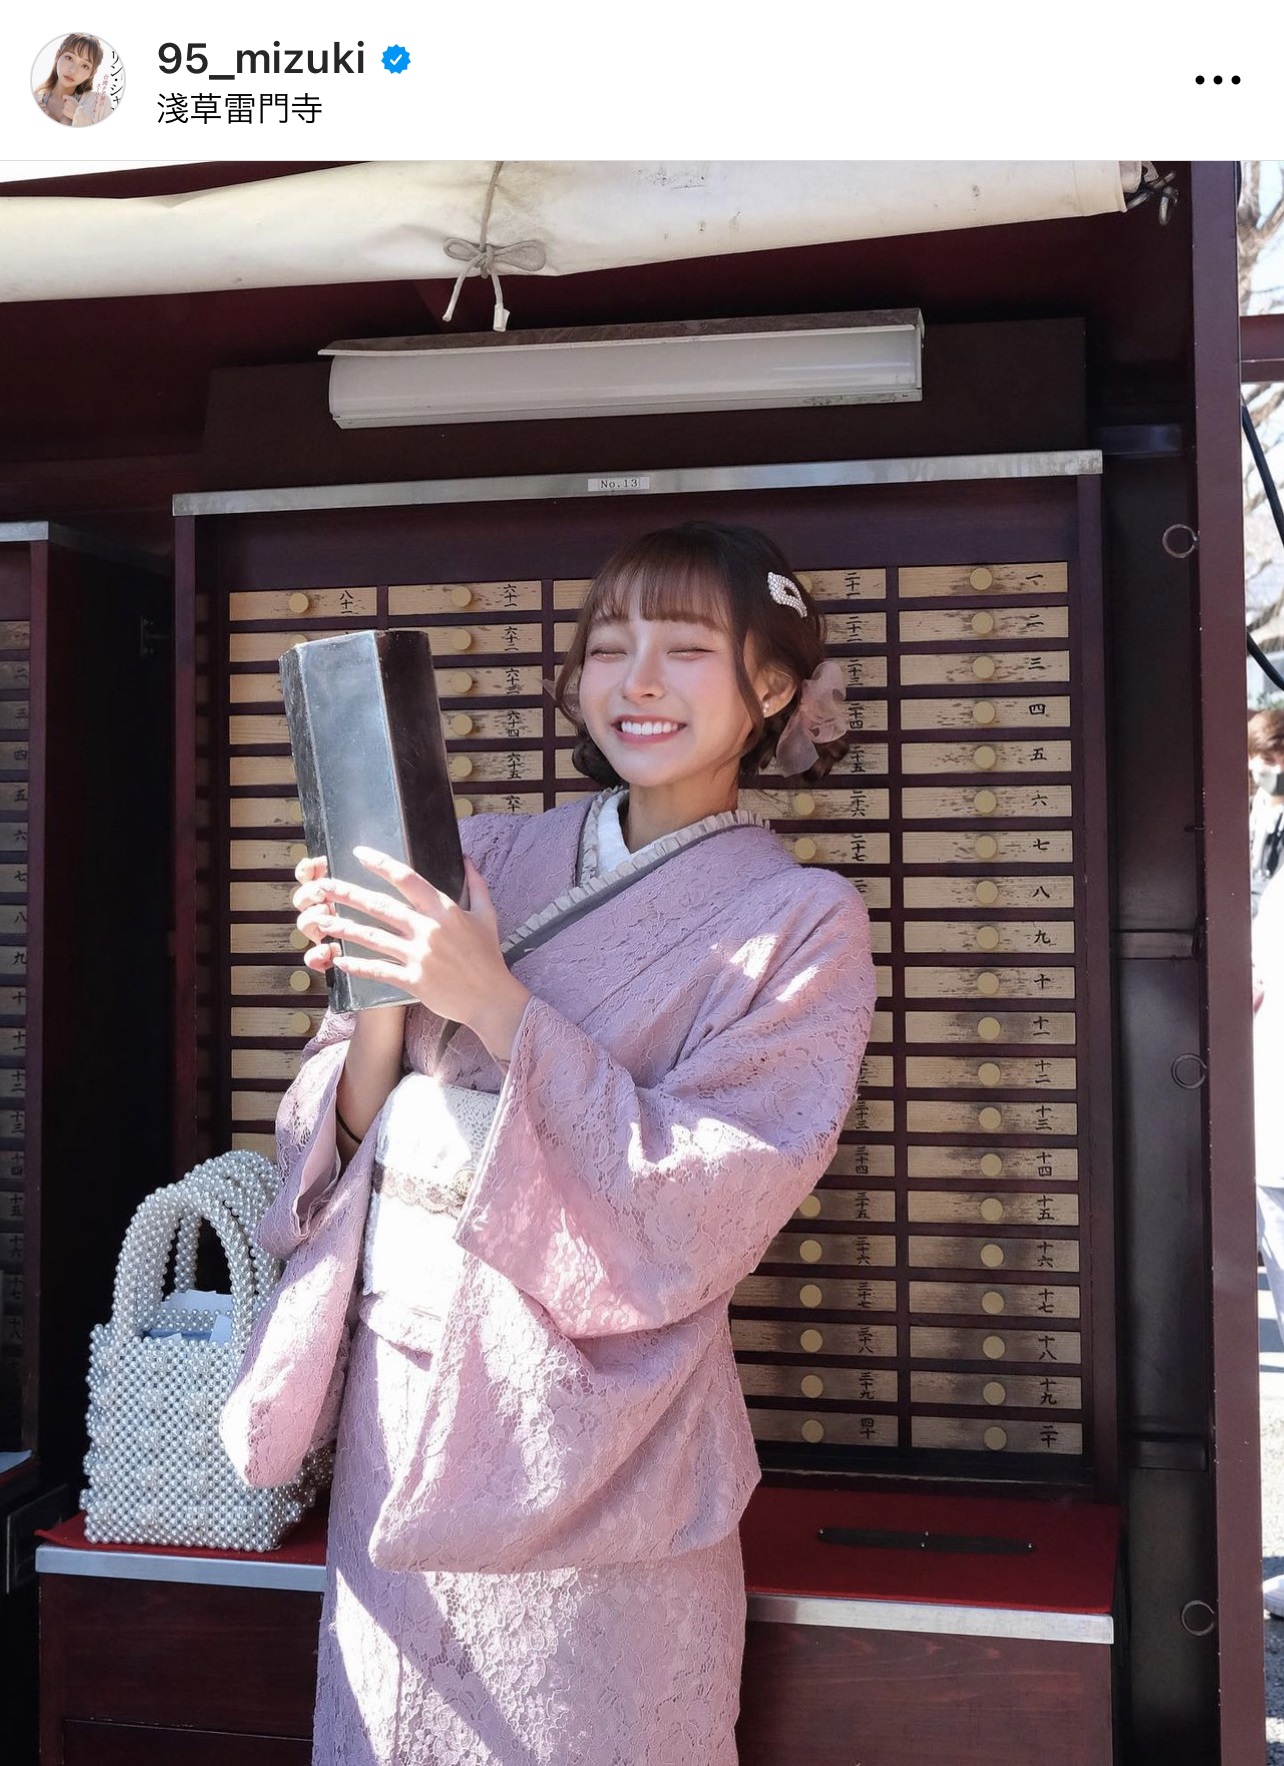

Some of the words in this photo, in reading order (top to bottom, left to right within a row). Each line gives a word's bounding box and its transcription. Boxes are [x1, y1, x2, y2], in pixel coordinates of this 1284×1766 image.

[600, 478, 638, 489] No.13
[503, 584, 518, 608] 六十一
[844, 572, 861, 596] 二十一
[339, 590, 354, 614] 八十一
[846, 616, 862, 642] 二十二
[1026, 614, 1044, 627] 二
[504, 626, 519, 652] 六十二
[847, 659, 863, 687] 二十三
[1028, 657, 1045, 670] 三
[848, 702, 864, 729] 二十四
[1028, 703, 1046, 715] 四
[507, 710, 521, 737] 六十四
[13, 750, 28, 761] 四
[507, 752, 522, 780] 六十五
[850, 745, 865, 773] 二十五
[1030, 747, 1047, 761] 五
[14, 788, 28, 802] 五
[506, 794, 521, 812] 六十
[850, 790, 867, 817] 二十六
[1031, 793, 1048, 806] 六
[13, 829, 27, 841] 六
[1032, 838, 1050, 851] 七
[850, 835, 867, 862] 二十七
[14, 870, 27, 882] 七
[1032, 885, 1050, 898] 八
[14, 911, 27, 923] 八
[1034, 930, 1051, 944] 九
[13, 952, 27, 965] 九
[1034, 973, 1051, 990] 十
[12, 991, 26, 1005] 十
[1033, 1016, 1050, 1036] 十一
[12, 1031, 26, 1051] 十一
[11, 1069, 25, 1092] 十二
[1035, 1060, 1051, 1084] 十二
[10, 1111, 24, 1133] 十三
[855, 1101, 870, 1129] 三十三
[1035, 1105, 1052, 1131] 十三
[855, 1146, 869, 1174] 三十四
[1036, 1151, 1052, 1177] 十四
[854, 1191, 870, 1219] 三十五
[1037, 1195, 1055, 1221] 十五
[856, 1236, 871, 1265] 三十六
[1037, 1241, 1054, 1268] 十六
[857, 1282, 872, 1309] 三十七
[1038, 1288, 1054, 1313] 十七
[858, 1326, 874, 1354] 三十八
[1038, 1335, 1057, 1360] 十八
[858, 1372, 874, 1400] 三十九
[1040, 1378, 1057, 1405] 十九
[860, 1417, 876, 1440] 四十
[1040, 1425, 1058, 1448] 二十
